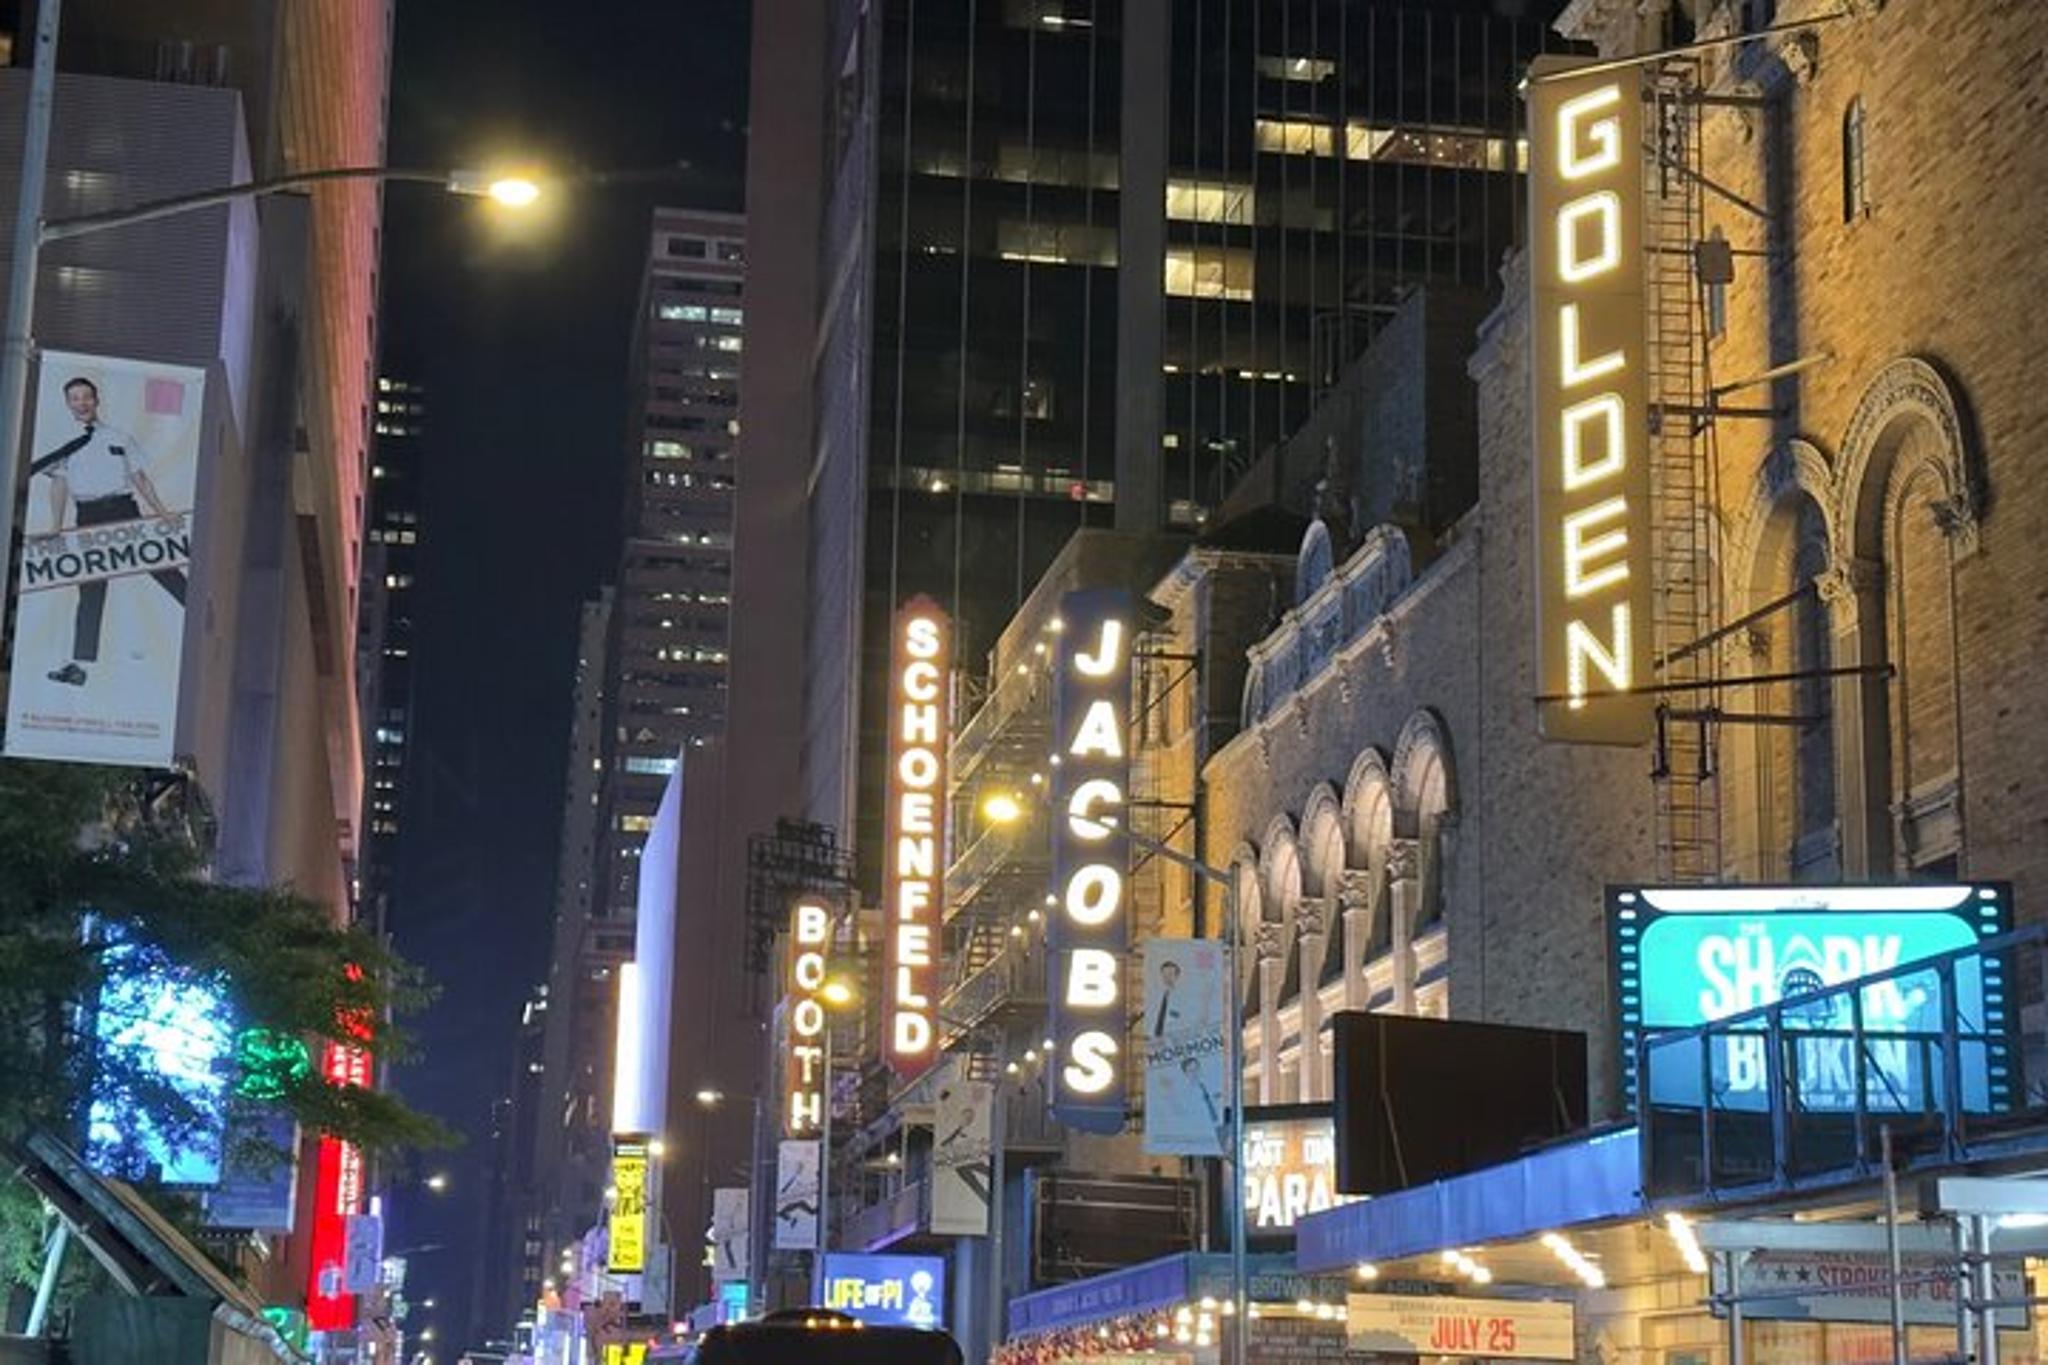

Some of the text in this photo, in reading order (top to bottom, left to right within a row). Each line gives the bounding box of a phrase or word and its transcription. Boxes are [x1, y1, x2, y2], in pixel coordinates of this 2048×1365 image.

[1556, 83, 1634, 711] GOLDEN
[25, 535, 189, 584] MORMON
[893, 618, 941, 1055] SCHOENFELD
[1062, 618, 1123, 1093] JACOBS
[790, 905, 828, 1131] BOOTH
[824, 1277, 865, 1310] LIFE
[882, 1279, 903, 1311] PI
[1430, 1315, 1516, 1351] JULY 25
